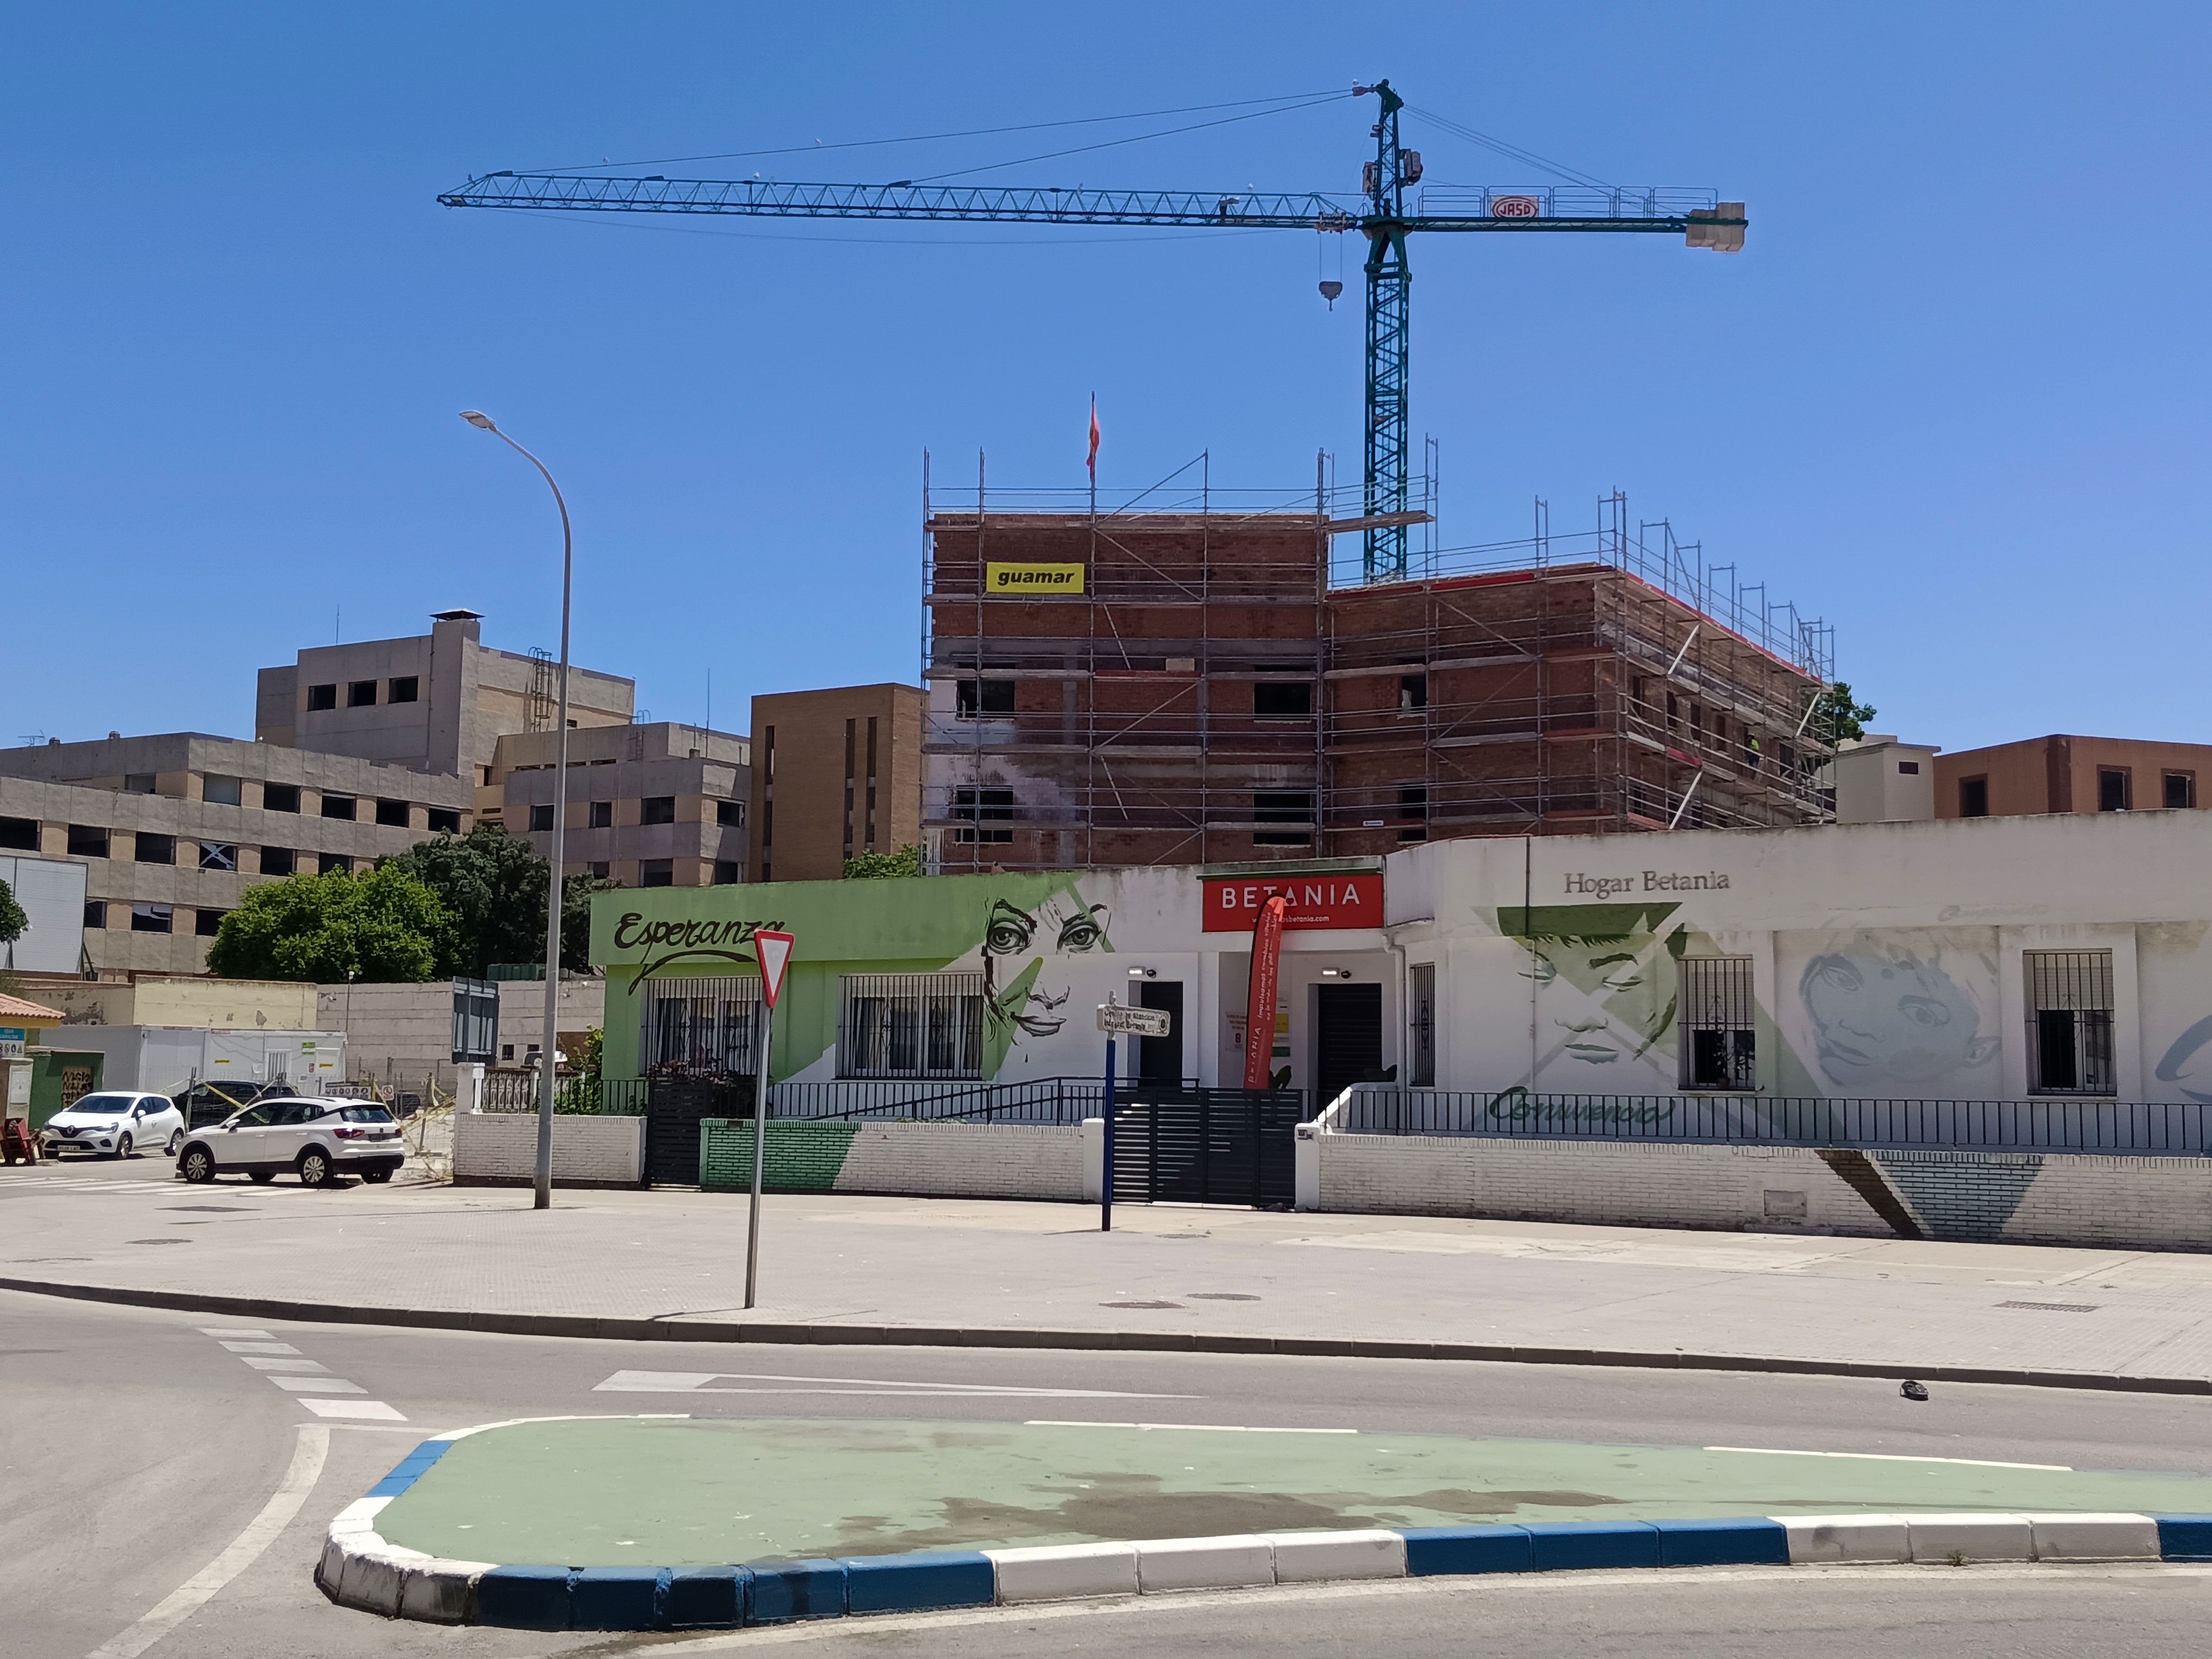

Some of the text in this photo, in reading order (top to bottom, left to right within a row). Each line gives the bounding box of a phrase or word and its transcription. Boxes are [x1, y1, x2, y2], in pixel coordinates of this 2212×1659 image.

[1500, 203, 1531, 216] JASO
[997, 572, 1075, 586] guamar
[1564, 870, 1731, 900] Hogar Betania
[1222, 883, 1360, 909] BETANIA
